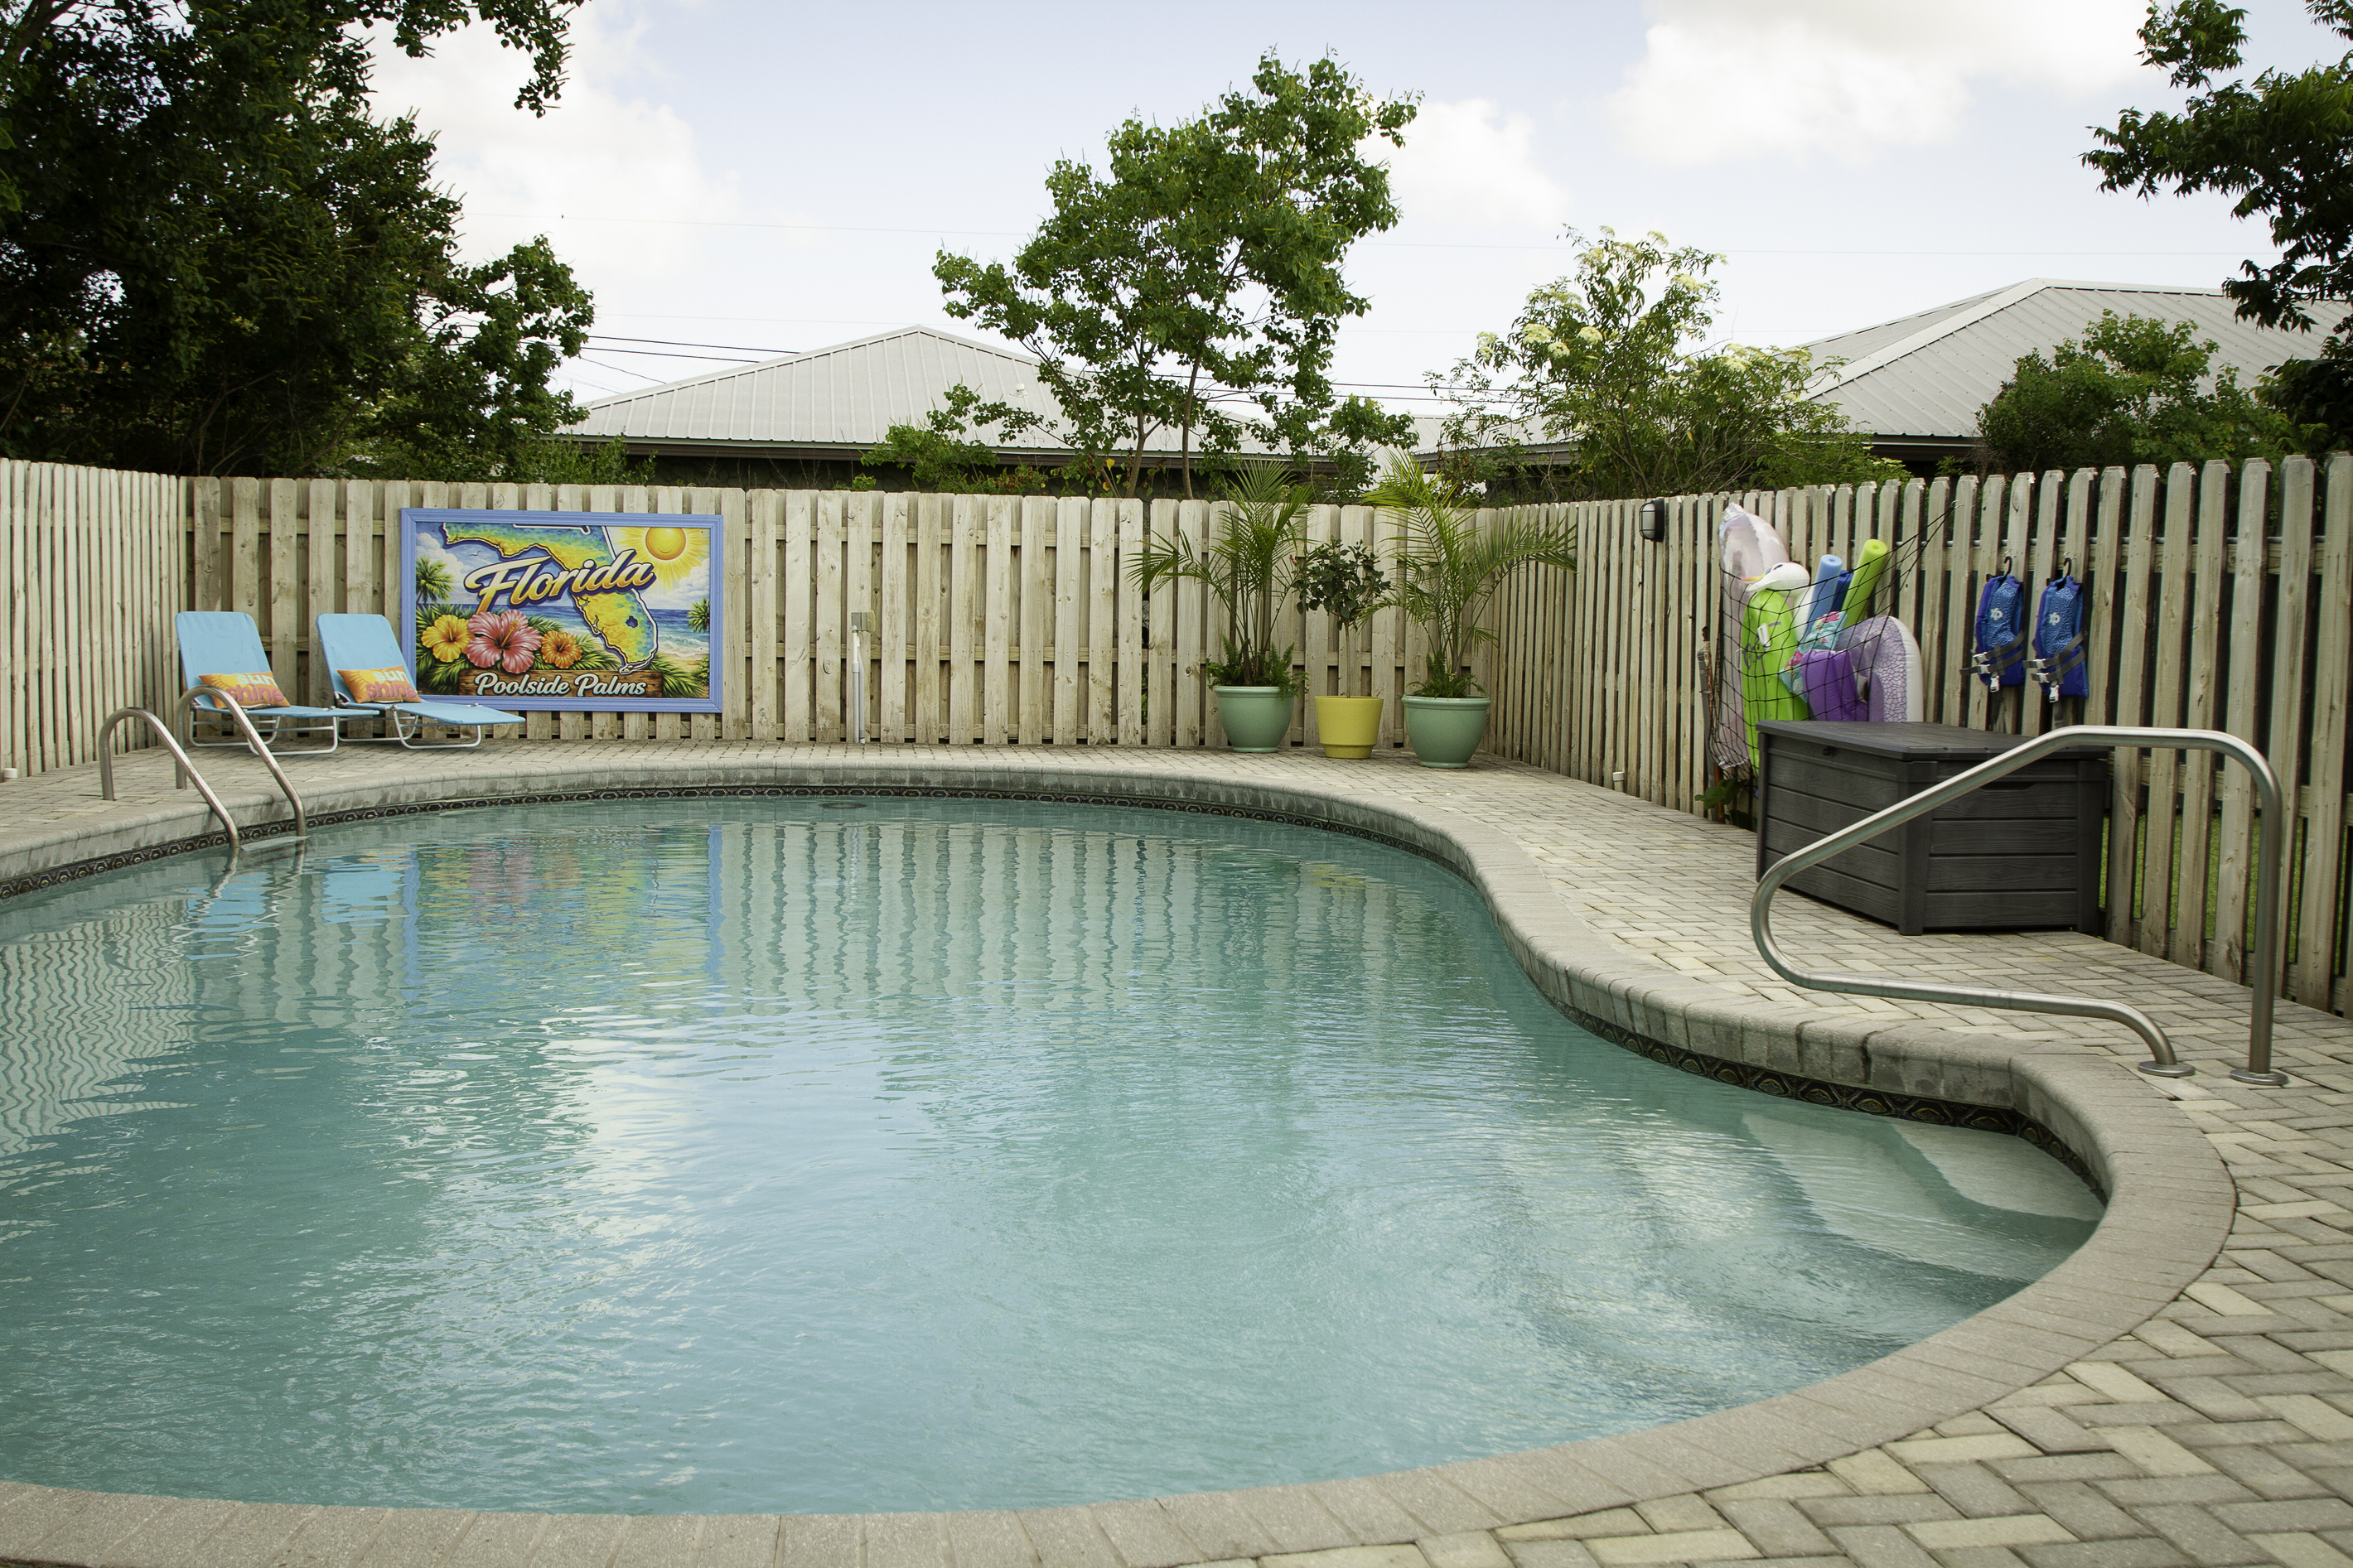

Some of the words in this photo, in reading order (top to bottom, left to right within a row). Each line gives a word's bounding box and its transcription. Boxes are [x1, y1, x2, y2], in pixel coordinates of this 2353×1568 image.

[464, 548, 654, 615] Florida
[235, 674, 278, 688] sun
[373, 670, 410, 683] sun
[475, 672, 570, 696] Poolside
[574, 673, 647, 697] Palms
[226, 683, 284, 702] shine
[365, 680, 417, 698] shine
